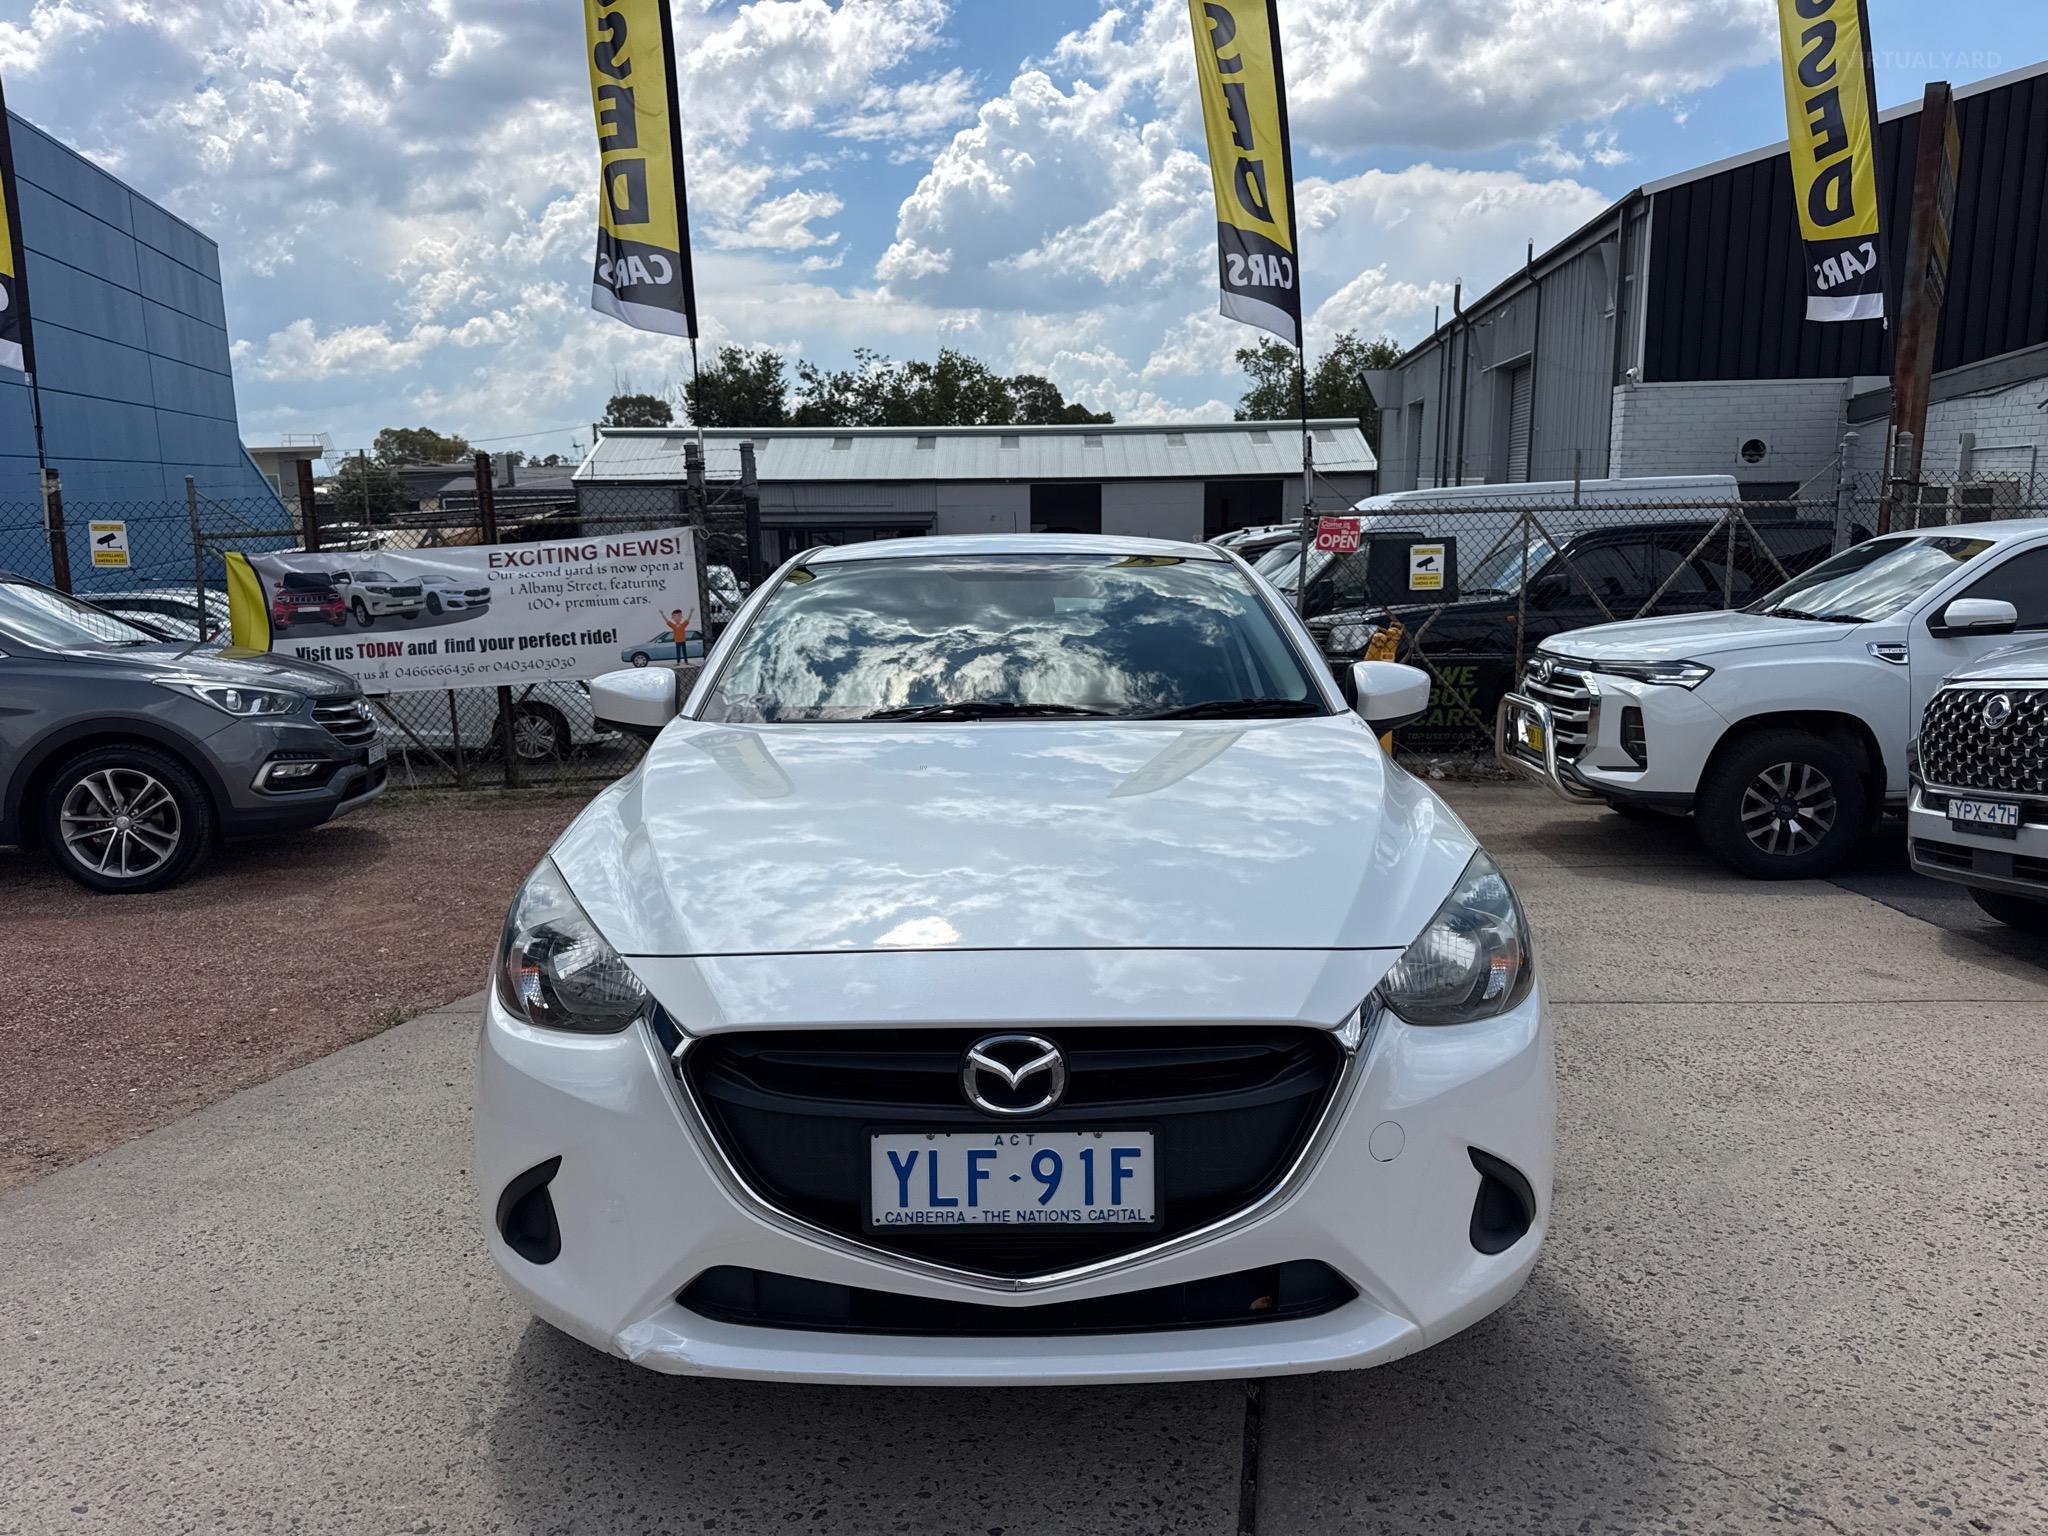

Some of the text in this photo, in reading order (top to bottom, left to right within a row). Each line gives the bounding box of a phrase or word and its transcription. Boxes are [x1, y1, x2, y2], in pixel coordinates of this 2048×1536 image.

[1319, 533, 1358, 549] OPEN
[488, 537, 681, 569] EXCITING NEWS!
[487, 561, 684, 582] Our second yard is now open at
[518, 581, 563, 596] Albany
[610, 577, 667, 591] featuring
[528, 595, 651, 612] 100+ premium cars.
[296, 628, 618, 661] Visit us TODAY and find your perfect ride!
[379, 670, 389, 679] at
[478, 664, 490, 673] or
[493, 656, 576, 672] 0403403030
[1435, 666, 1480, 685] WE
[1428, 687, 1479, 706] BUY
[884, 1211, 966, 1223] CANBERRA
[982, 1210, 1011, 1223] THE
[1016, 1209, 1082, 1223] NATION'S
[1088, 1208, 1145, 1222] CAPITAL
